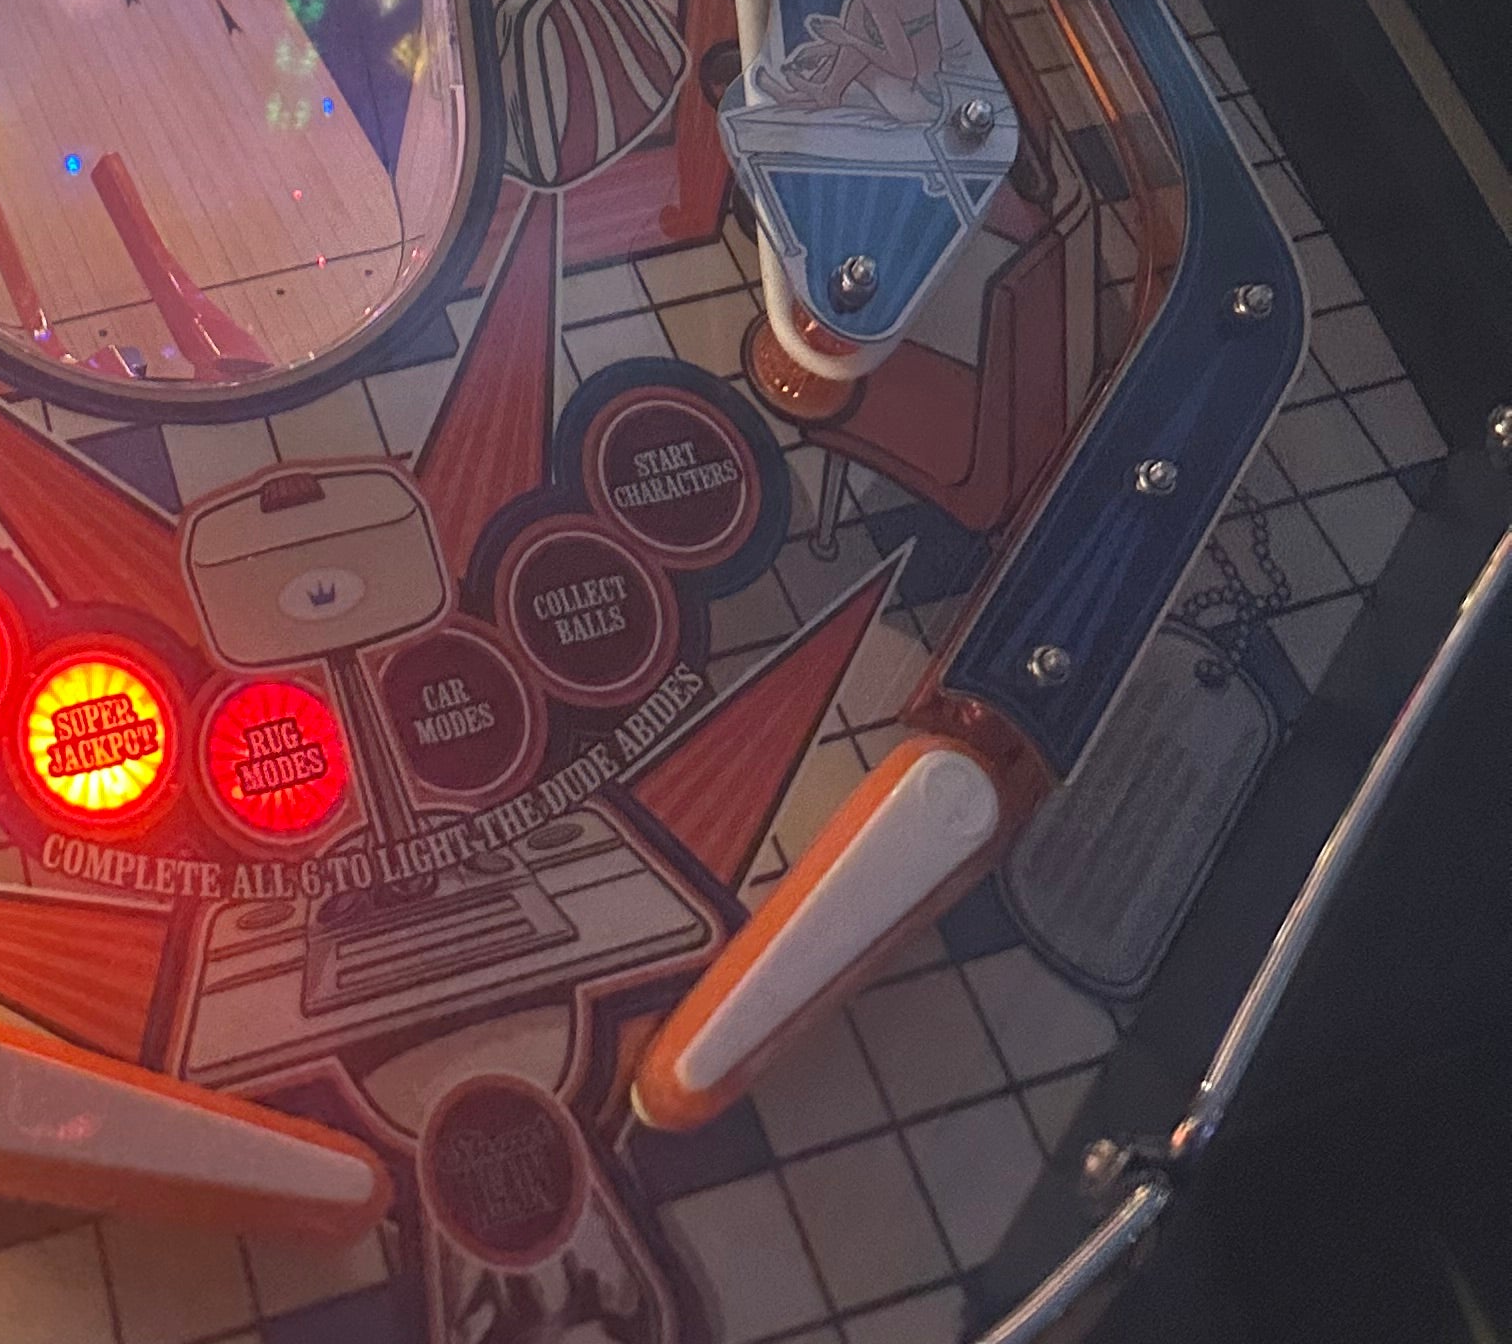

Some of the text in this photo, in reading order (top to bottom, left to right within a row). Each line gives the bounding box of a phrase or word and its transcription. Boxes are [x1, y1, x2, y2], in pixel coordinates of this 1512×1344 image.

[634, 441, 697, 477] START
[614, 459, 738, 508] CHARACTERS
[533, 575, 628, 621] COLLECT
[554, 605, 626, 645] BALLS
[422, 678, 471, 712] CAR
[56, 699, 136, 742] SUPER
[248, 722, 300, 759] RUG
[413, 703, 496, 745] MODES
[50, 723, 155, 775] JACKPOT
[239, 747, 325, 792] MODES
[42, 833, 221, 898] COMPLETE
[232, 863, 294, 898] ALL
[326, 850, 372, 891] TO
[379, 827, 476, 883] LIGHT
[475, 790, 544, 848] THE
[540, 742, 620, 815] DUDE
[614, 662, 704, 762] ABIDES
